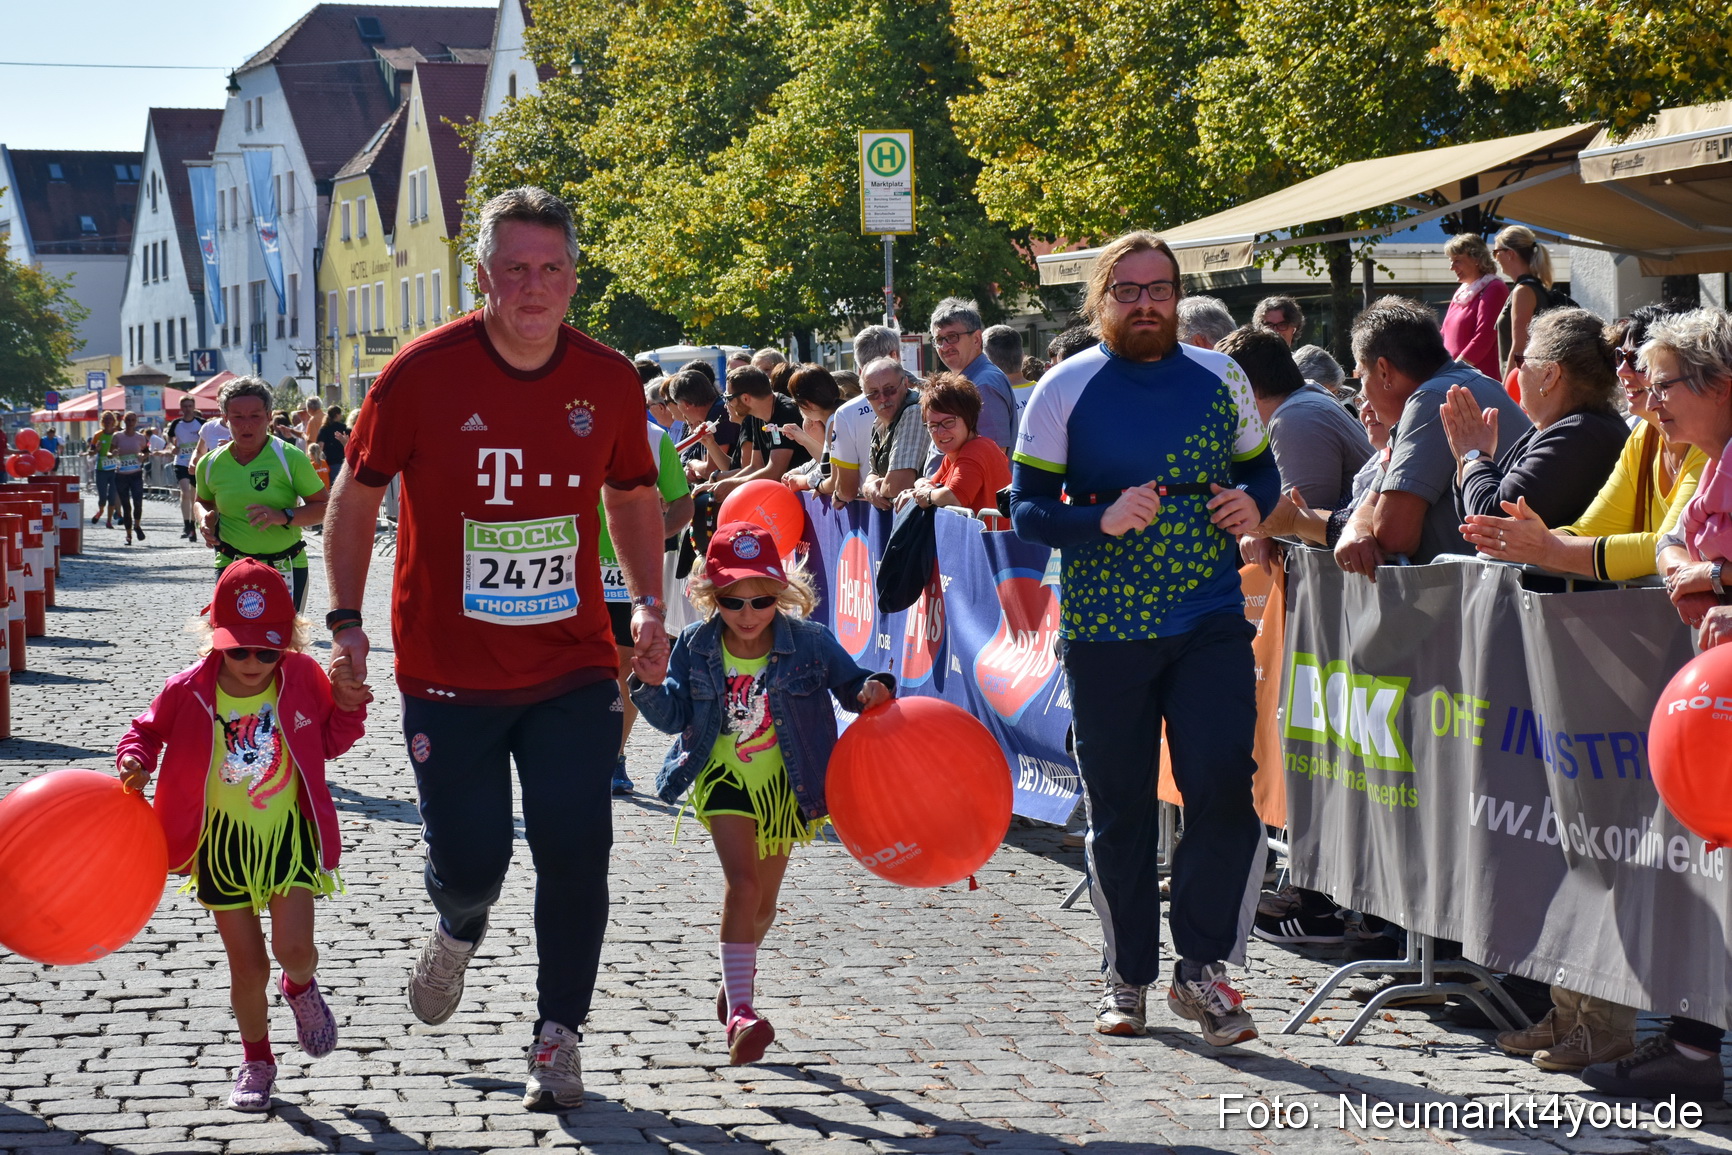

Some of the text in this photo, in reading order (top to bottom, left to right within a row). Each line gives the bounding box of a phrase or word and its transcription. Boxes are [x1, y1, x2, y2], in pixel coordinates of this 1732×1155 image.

[877, 146, 896, 168] H
[350, 260, 368, 280] HOTEL
[858, 405, 873, 416] 20.
[461, 424, 488, 432] adidas
[475, 522, 570, 548] BOCK
[479, 555, 564, 590] 2473
[475, 594, 570, 614] THORSTEN
[886, 848, 922, 869] energie
